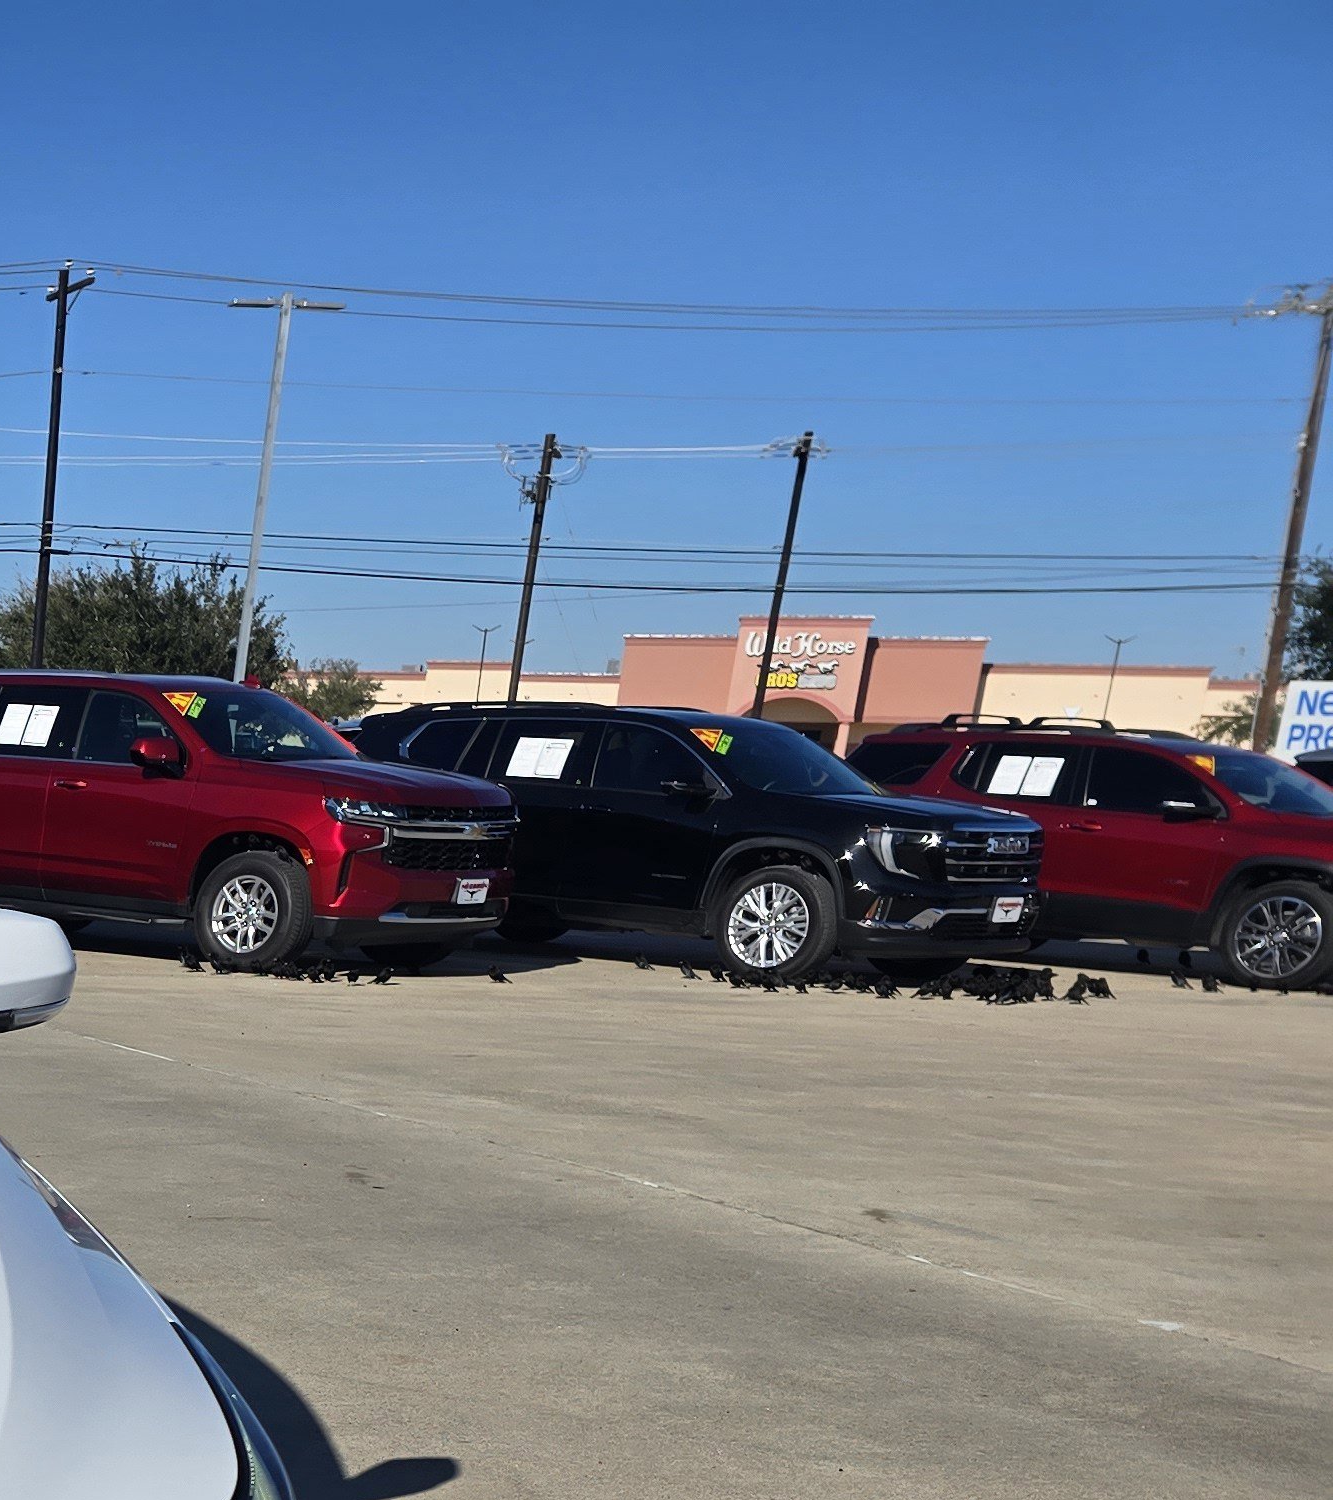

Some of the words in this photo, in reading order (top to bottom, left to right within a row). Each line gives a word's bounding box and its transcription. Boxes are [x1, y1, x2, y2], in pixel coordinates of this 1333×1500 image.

[744, 632, 792, 657] Wld
[791, 632, 856, 657] Horse
[755, 672, 798, 688] ROS
